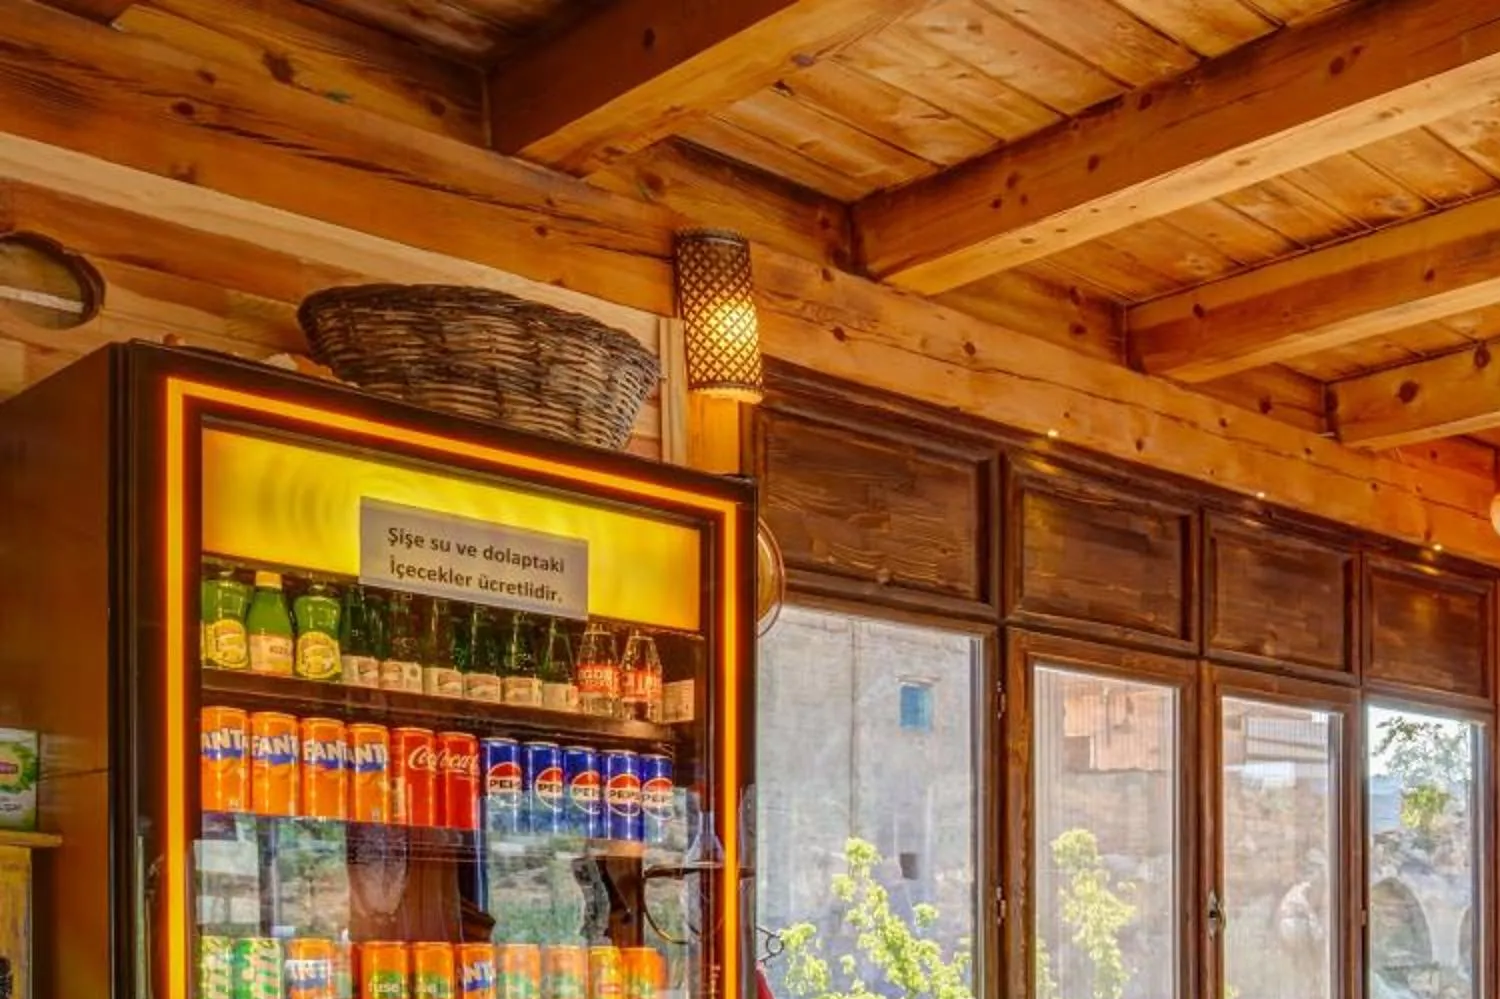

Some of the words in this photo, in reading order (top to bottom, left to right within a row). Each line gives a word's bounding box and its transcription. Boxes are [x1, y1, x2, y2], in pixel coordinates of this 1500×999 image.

[387, 527, 425, 549] Şişe
[430, 538, 451, 551] su
[455, 543, 478, 556] ve
[482, 545, 565, 573] dolaptaki
[478, 574, 564, 604] ücretlidir.
